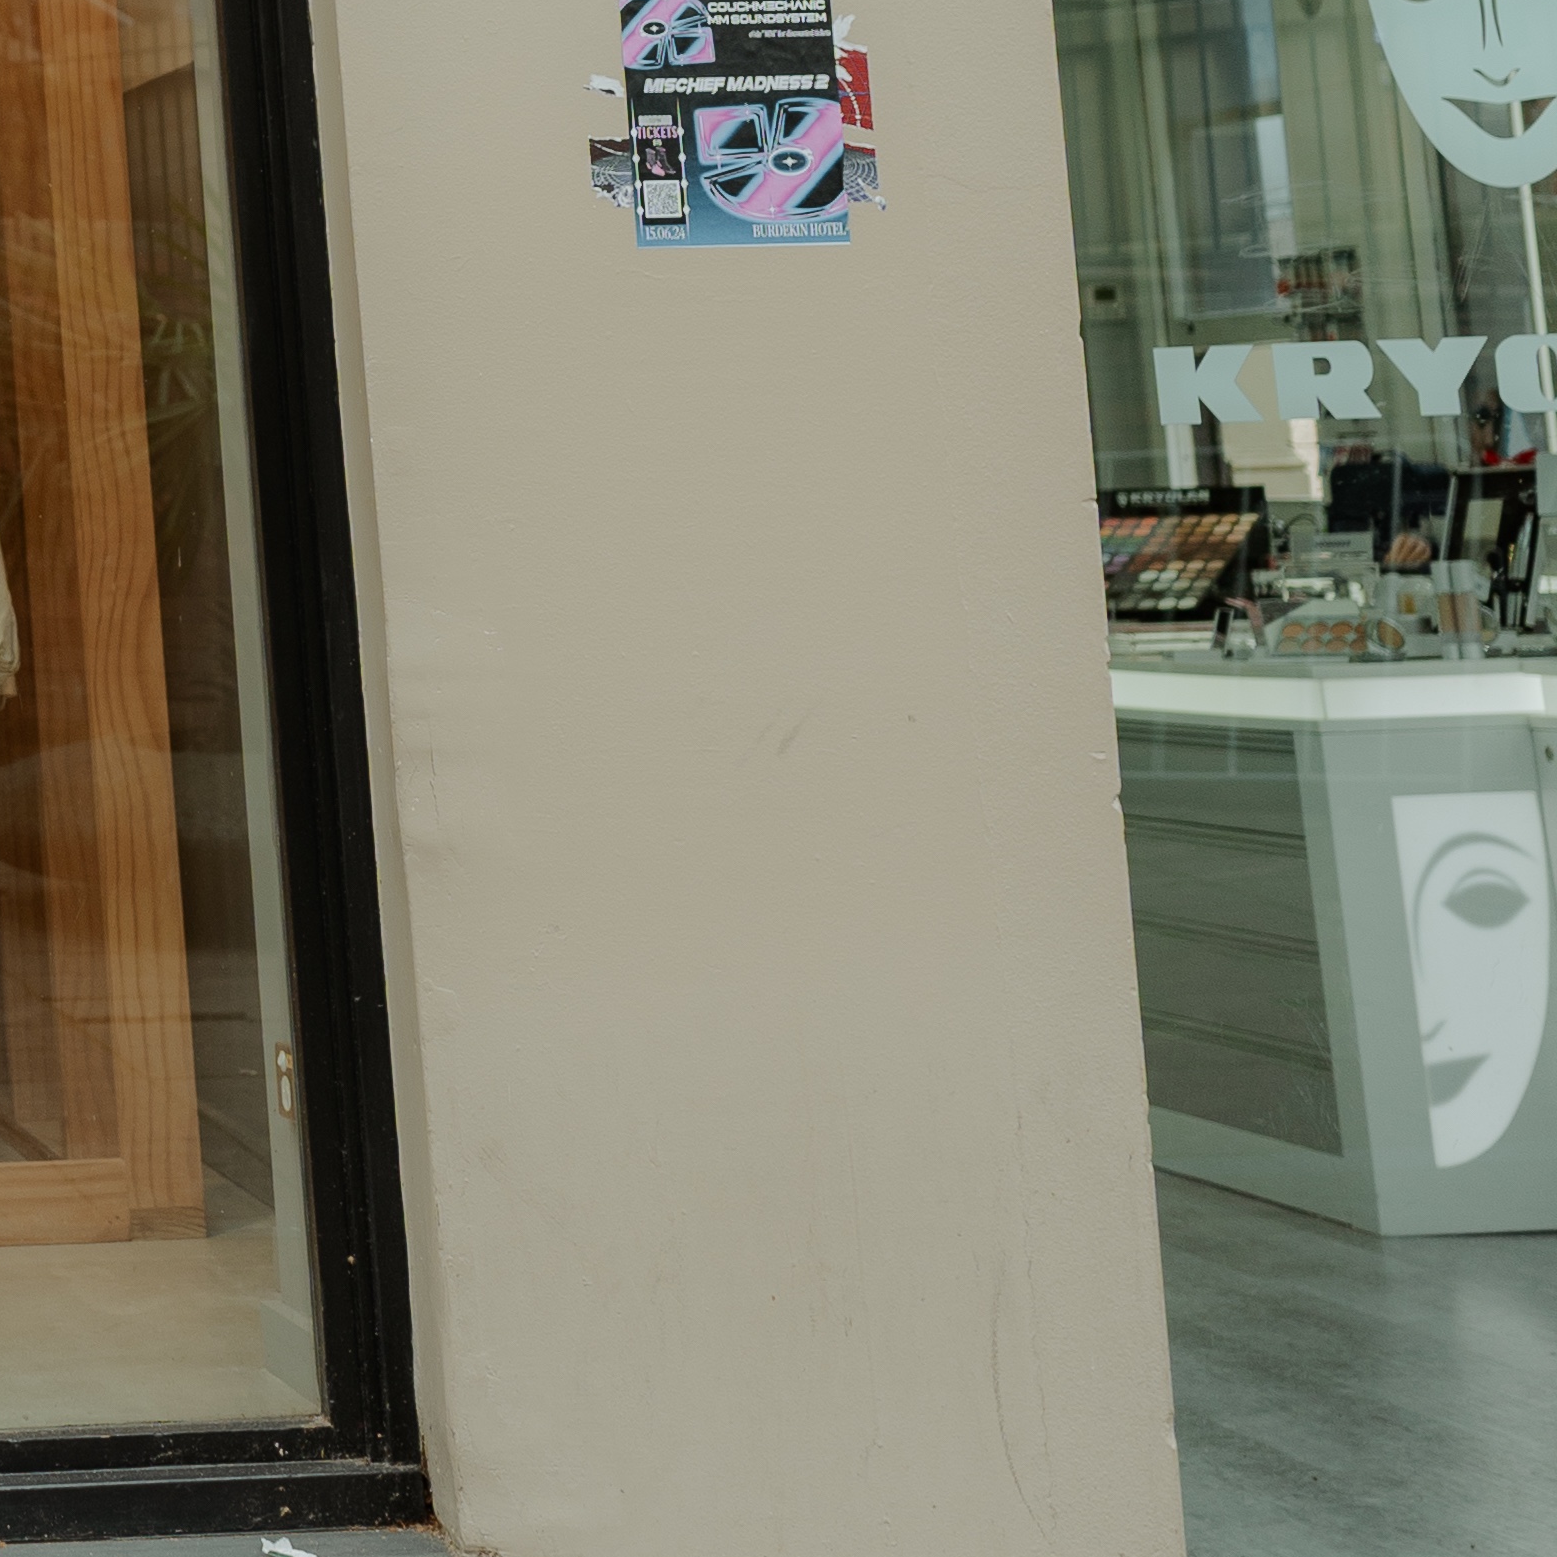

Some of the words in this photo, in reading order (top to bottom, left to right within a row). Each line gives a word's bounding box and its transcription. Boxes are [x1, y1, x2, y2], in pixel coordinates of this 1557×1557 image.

[707, 0, 826, 13] COUCHMECHANIC
[708, 14, 729, 25] MM
[730, 12, 827, 25] SOUNDSYSTEM
[643, 76, 726, 94] MISCHIEF
[726, 75, 814, 93] MADNESS
[814, 74, 830, 90] 2
[636, 125, 678, 140] TICKETS
[752, 223, 808, 238] BURDEKIN
[810, 222, 847, 237] HOTEL
